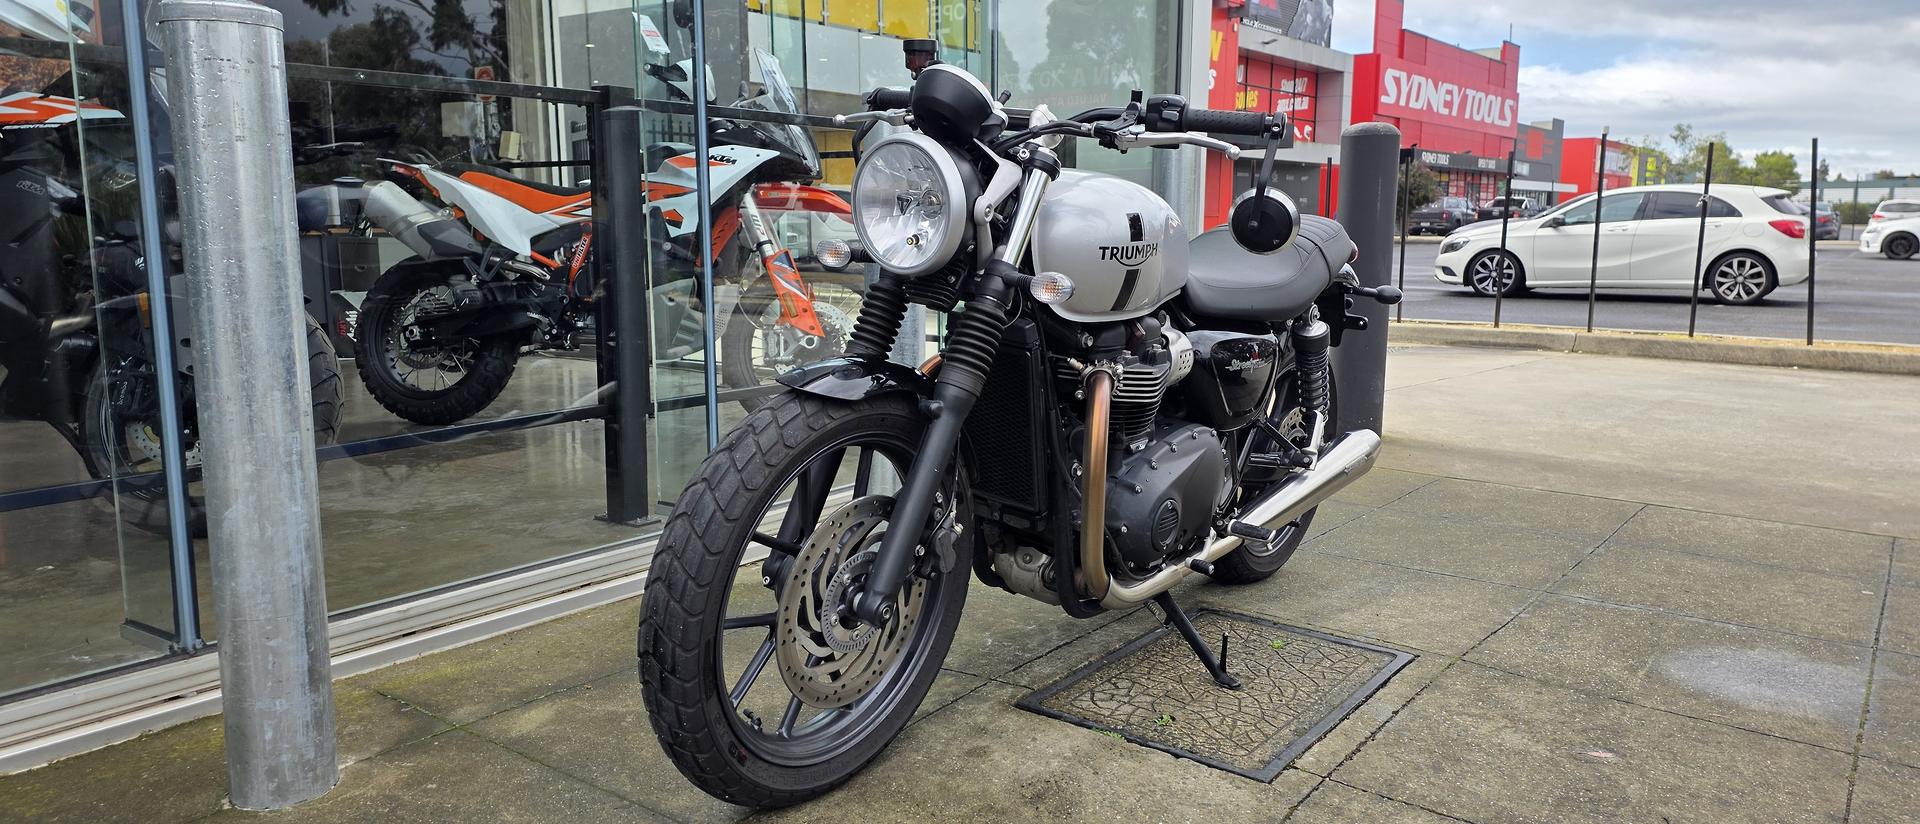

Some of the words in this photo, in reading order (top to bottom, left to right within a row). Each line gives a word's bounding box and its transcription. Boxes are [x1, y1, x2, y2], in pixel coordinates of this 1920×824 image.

[1381, 68, 1464, 116] SYDNEY
[1464, 88, 1514, 127] TOOLS
[1098, 243, 1159, 267] TRIUMPH
